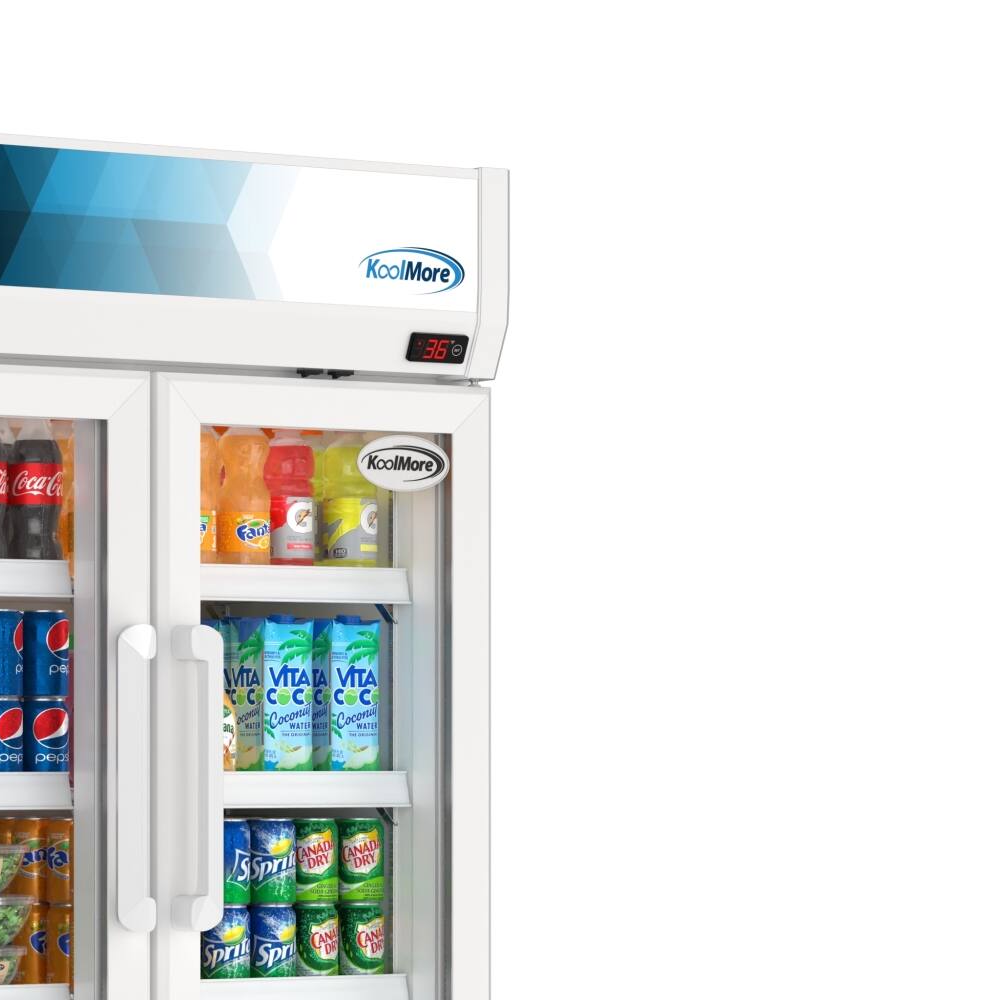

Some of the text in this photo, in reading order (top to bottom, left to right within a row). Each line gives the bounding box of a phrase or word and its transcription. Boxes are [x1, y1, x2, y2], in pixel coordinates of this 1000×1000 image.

[366, 259, 450, 283] KoolMore
[423, 339, 449, 359] 36
[367, 455, 434, 472] KoolMore
[269, 665, 311, 687] VITA
[336, 665, 377, 687] VITA
[307, 853, 329, 869] DRY
[353, 851, 375, 868] DRY
